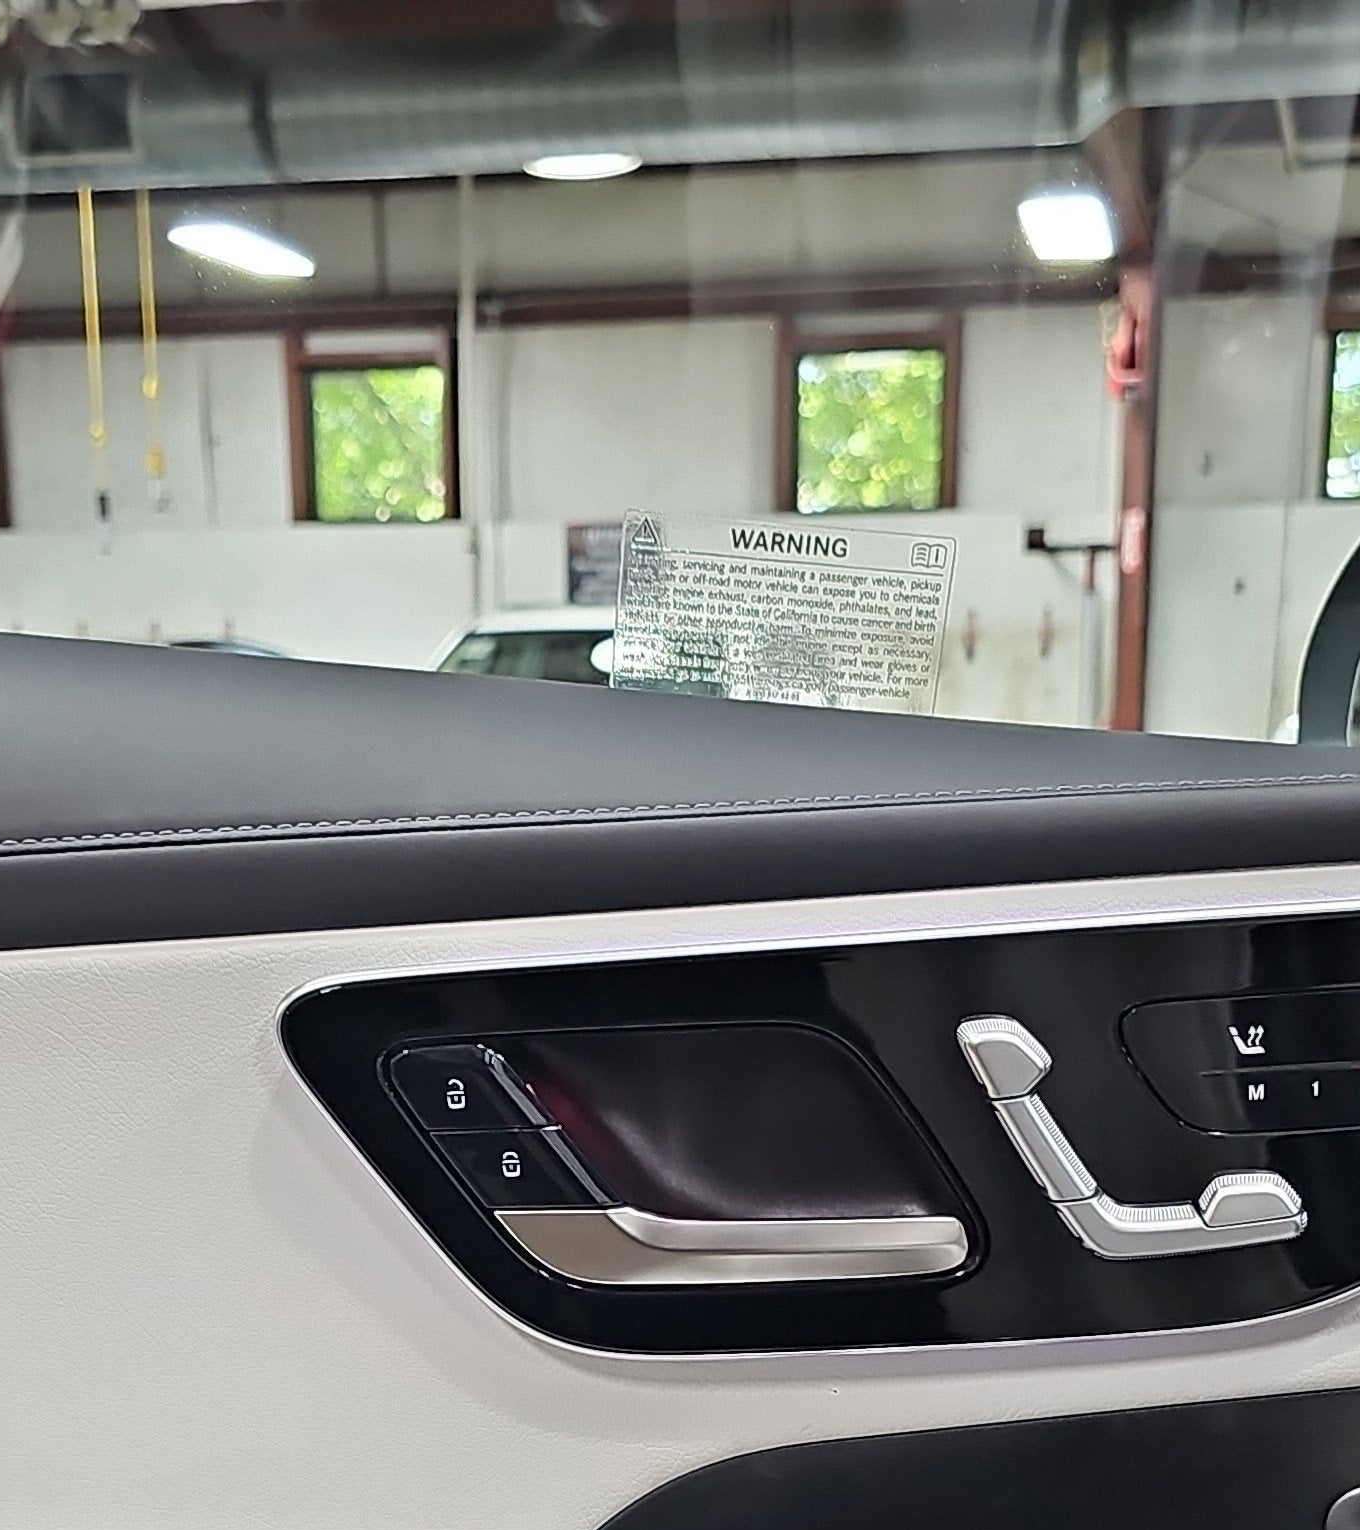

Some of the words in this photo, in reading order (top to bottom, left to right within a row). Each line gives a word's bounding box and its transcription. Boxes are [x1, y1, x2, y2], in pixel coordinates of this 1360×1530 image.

[732, 528, 848, 557] WARNING
[682, 559, 725, 574] servicing
[729, 562, 746, 574] and
[750, 565, 805, 581] maintaining
[809, 571, 814, 580] a
[819, 572, 867, 586] passenger
[872, 575, 906, 589] vehicle,
[910, 578, 941, 592] pickup
[678, 573, 688, 583] or
[692, 573, 729, 587] off-road
[733, 577, 762, 589] motor
[765, 579, 797, 592] vehicle
[801, 584, 818, 594] can
[822, 586, 855, 599] expose
[859, 589, 876, 601] you
[880, 590, 889, 600] to
[892, 591, 939, 605] chemicals
[707, 589, 746, 603] exhaust,
[750, 592, 783, 605] carbon
[787, 597, 835, 611] monoxide,
[839, 600, 890, 616] phthalates,
[894, 605, 912, 616] and
[673, 599, 704, 612] known
[706, 602, 715, 614] to
[718, 603, 732, 615] the
[734, 605, 759, 617] State
[761, 607, 771, 618] of
[773, 608, 817, 622] California
[819, 613, 829, 623] to
[831, 615, 858, 626] cause
[861, 617, 892, 629] cancer
[894, 619, 912, 630] and
[914, 620, 935, 632] birth
[815, 626, 856, 639] minimize
[909, 634, 934, 646] avoid
[831, 641, 862, 654] except
[867, 645, 878, 654] as
[839, 656, 856, 666] and
[861, 658, 883, 668] wear
[887, 660, 916, 672] gloves
[920, 663, 930, 672] or
[886, 673, 902, 684] For
[904, 676, 928, 686] more
[1248, 1085, 1265, 1101] M
[1312, 1082, 1319, 1097] 1
